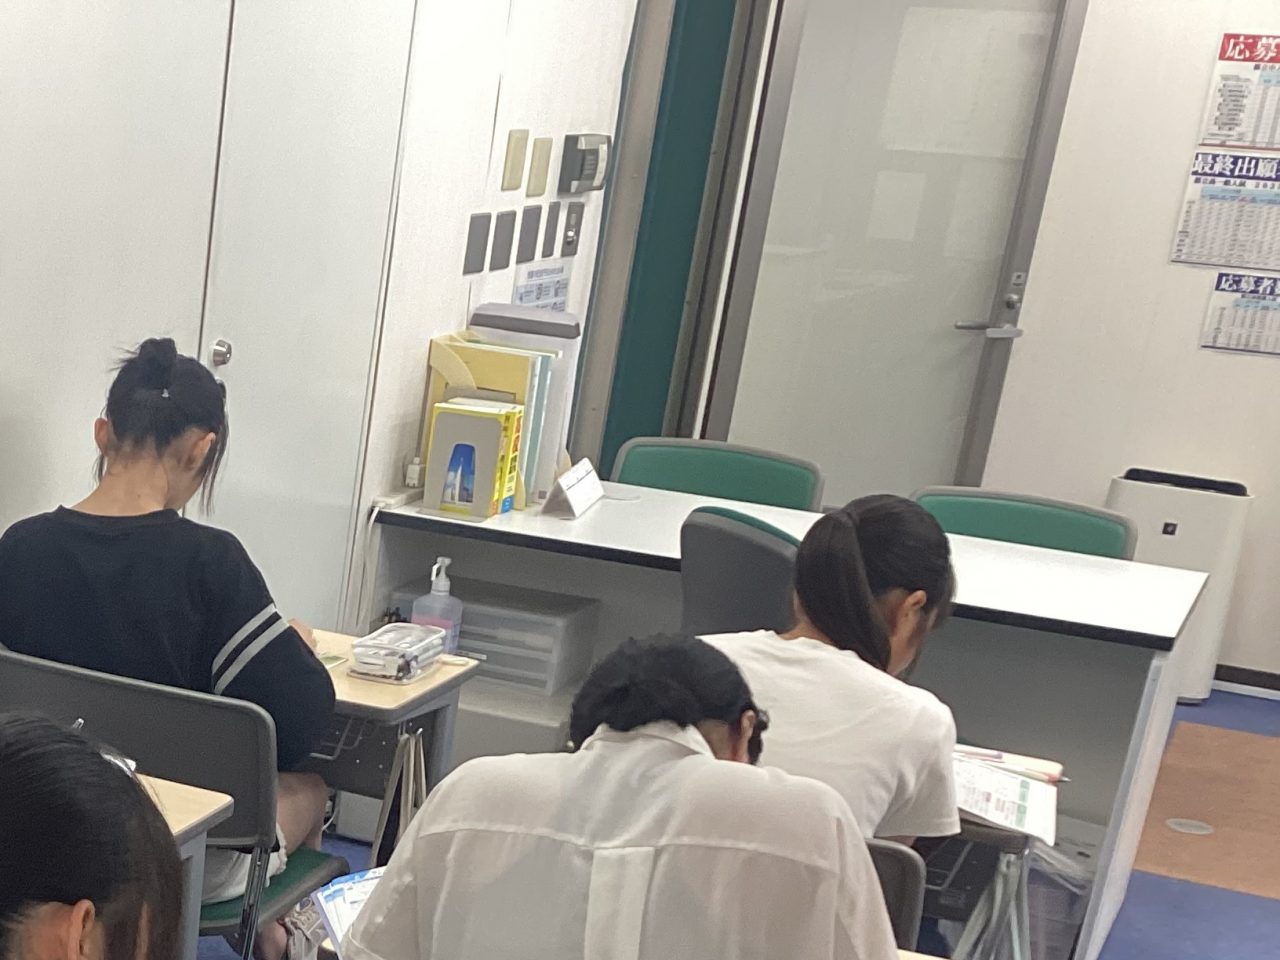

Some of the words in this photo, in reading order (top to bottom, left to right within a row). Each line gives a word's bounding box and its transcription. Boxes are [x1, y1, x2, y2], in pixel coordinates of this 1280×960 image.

[1192, 153, 1280, 179] 最終出願
[1219, 274, 1280, 295] 応募者
